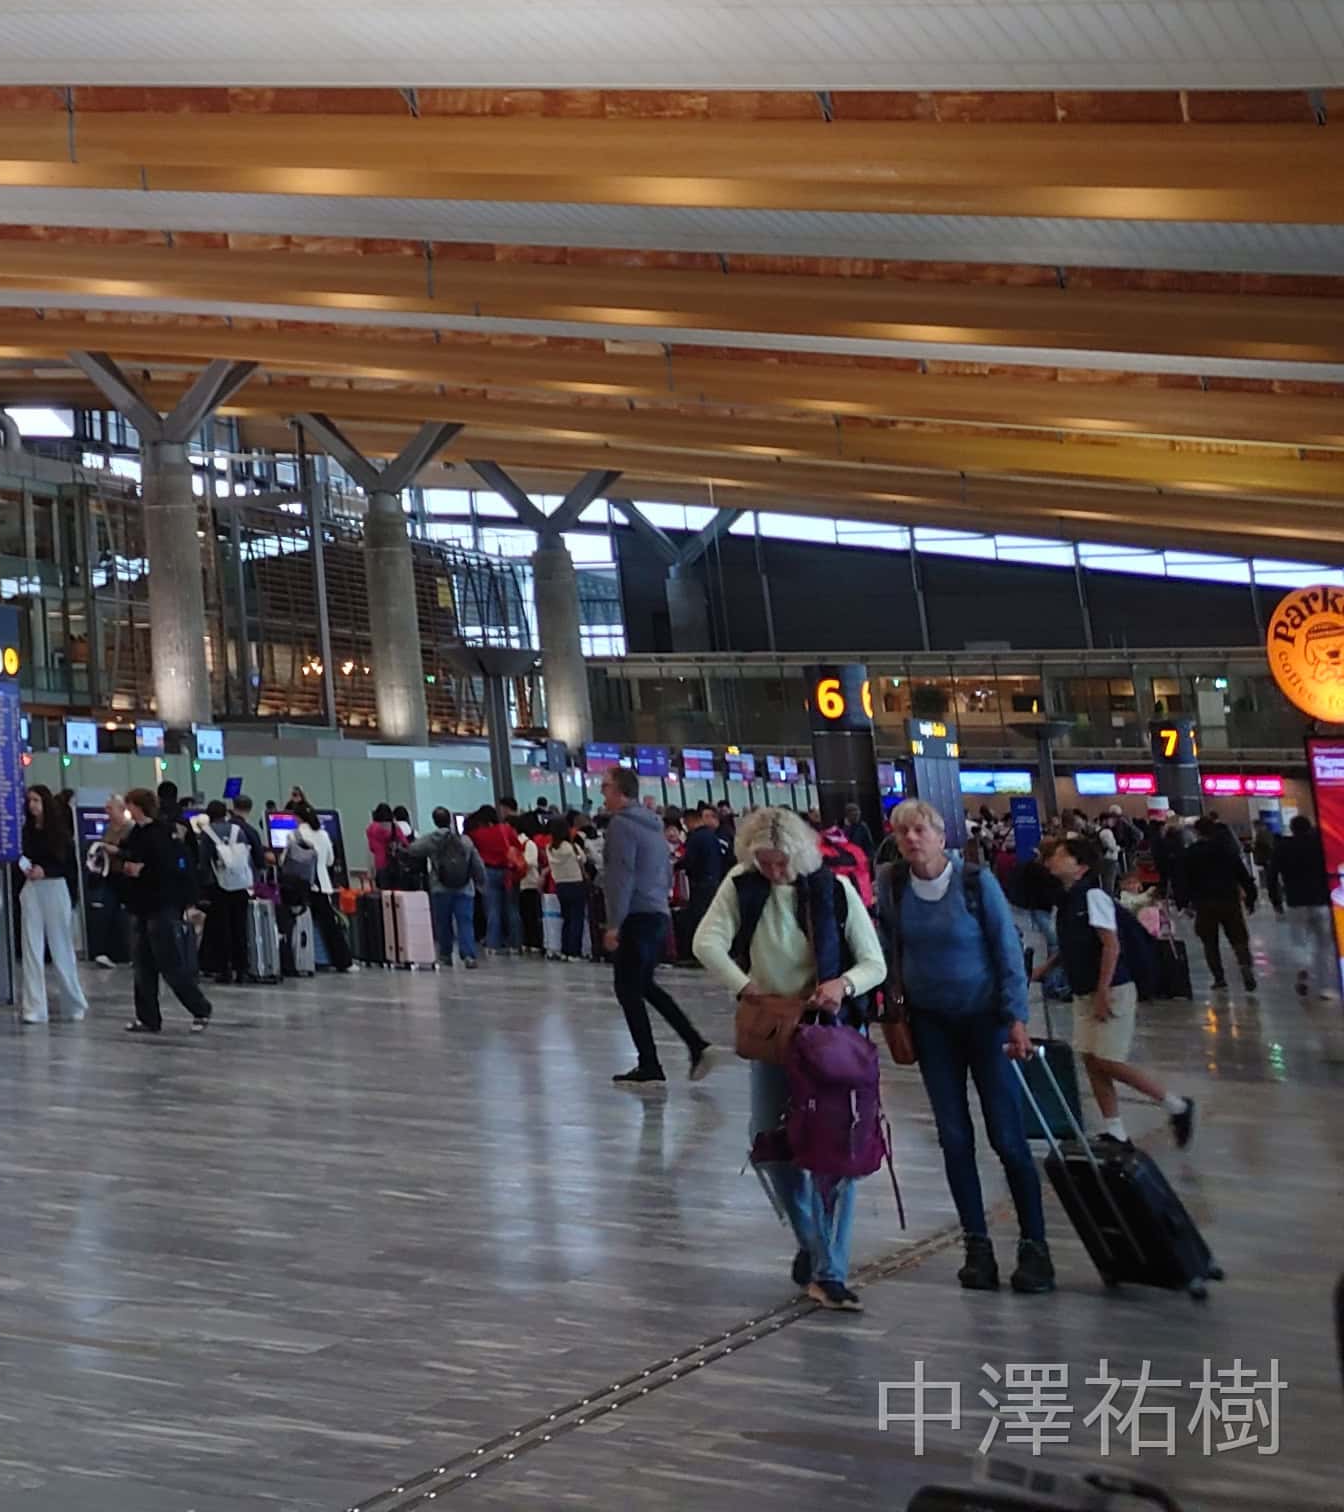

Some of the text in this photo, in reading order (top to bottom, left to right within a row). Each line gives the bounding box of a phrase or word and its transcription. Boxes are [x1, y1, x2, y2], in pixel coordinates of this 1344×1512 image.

[1273, 586, 1344, 646] Park
[817, 678, 845, 719] 6
[1160, 729, 1178, 757] 7
